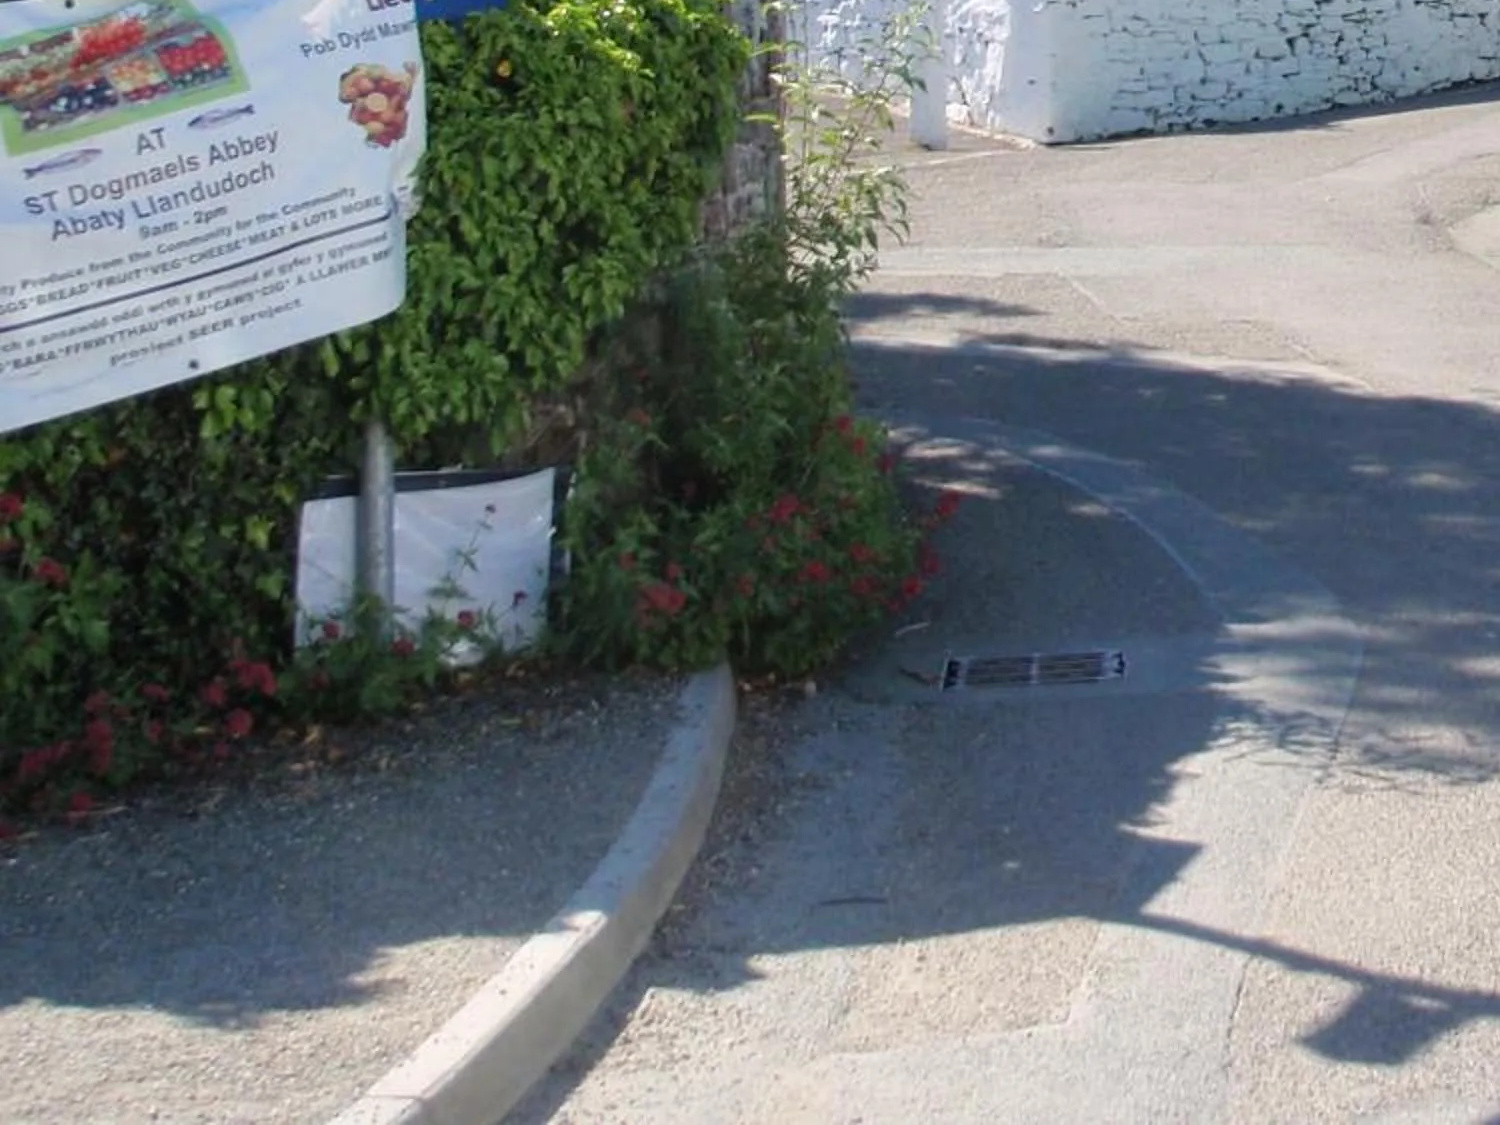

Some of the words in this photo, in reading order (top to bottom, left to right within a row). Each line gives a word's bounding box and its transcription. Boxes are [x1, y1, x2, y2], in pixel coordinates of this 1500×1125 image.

[300, 38, 337, 57] Pob
[136, 127, 167, 156] AT
[23, 190, 60, 216] ST
[67, 154, 201, 208] Dogmaels
[208, 130, 279, 166] Abbey
[51, 208, 126, 242] Abaty
[131, 160, 275, 219] Llandudoch
[140, 222, 179, 238] 9am
[193, 205, 228, 225] 2pm
[157, 226, 232, 254] Community
